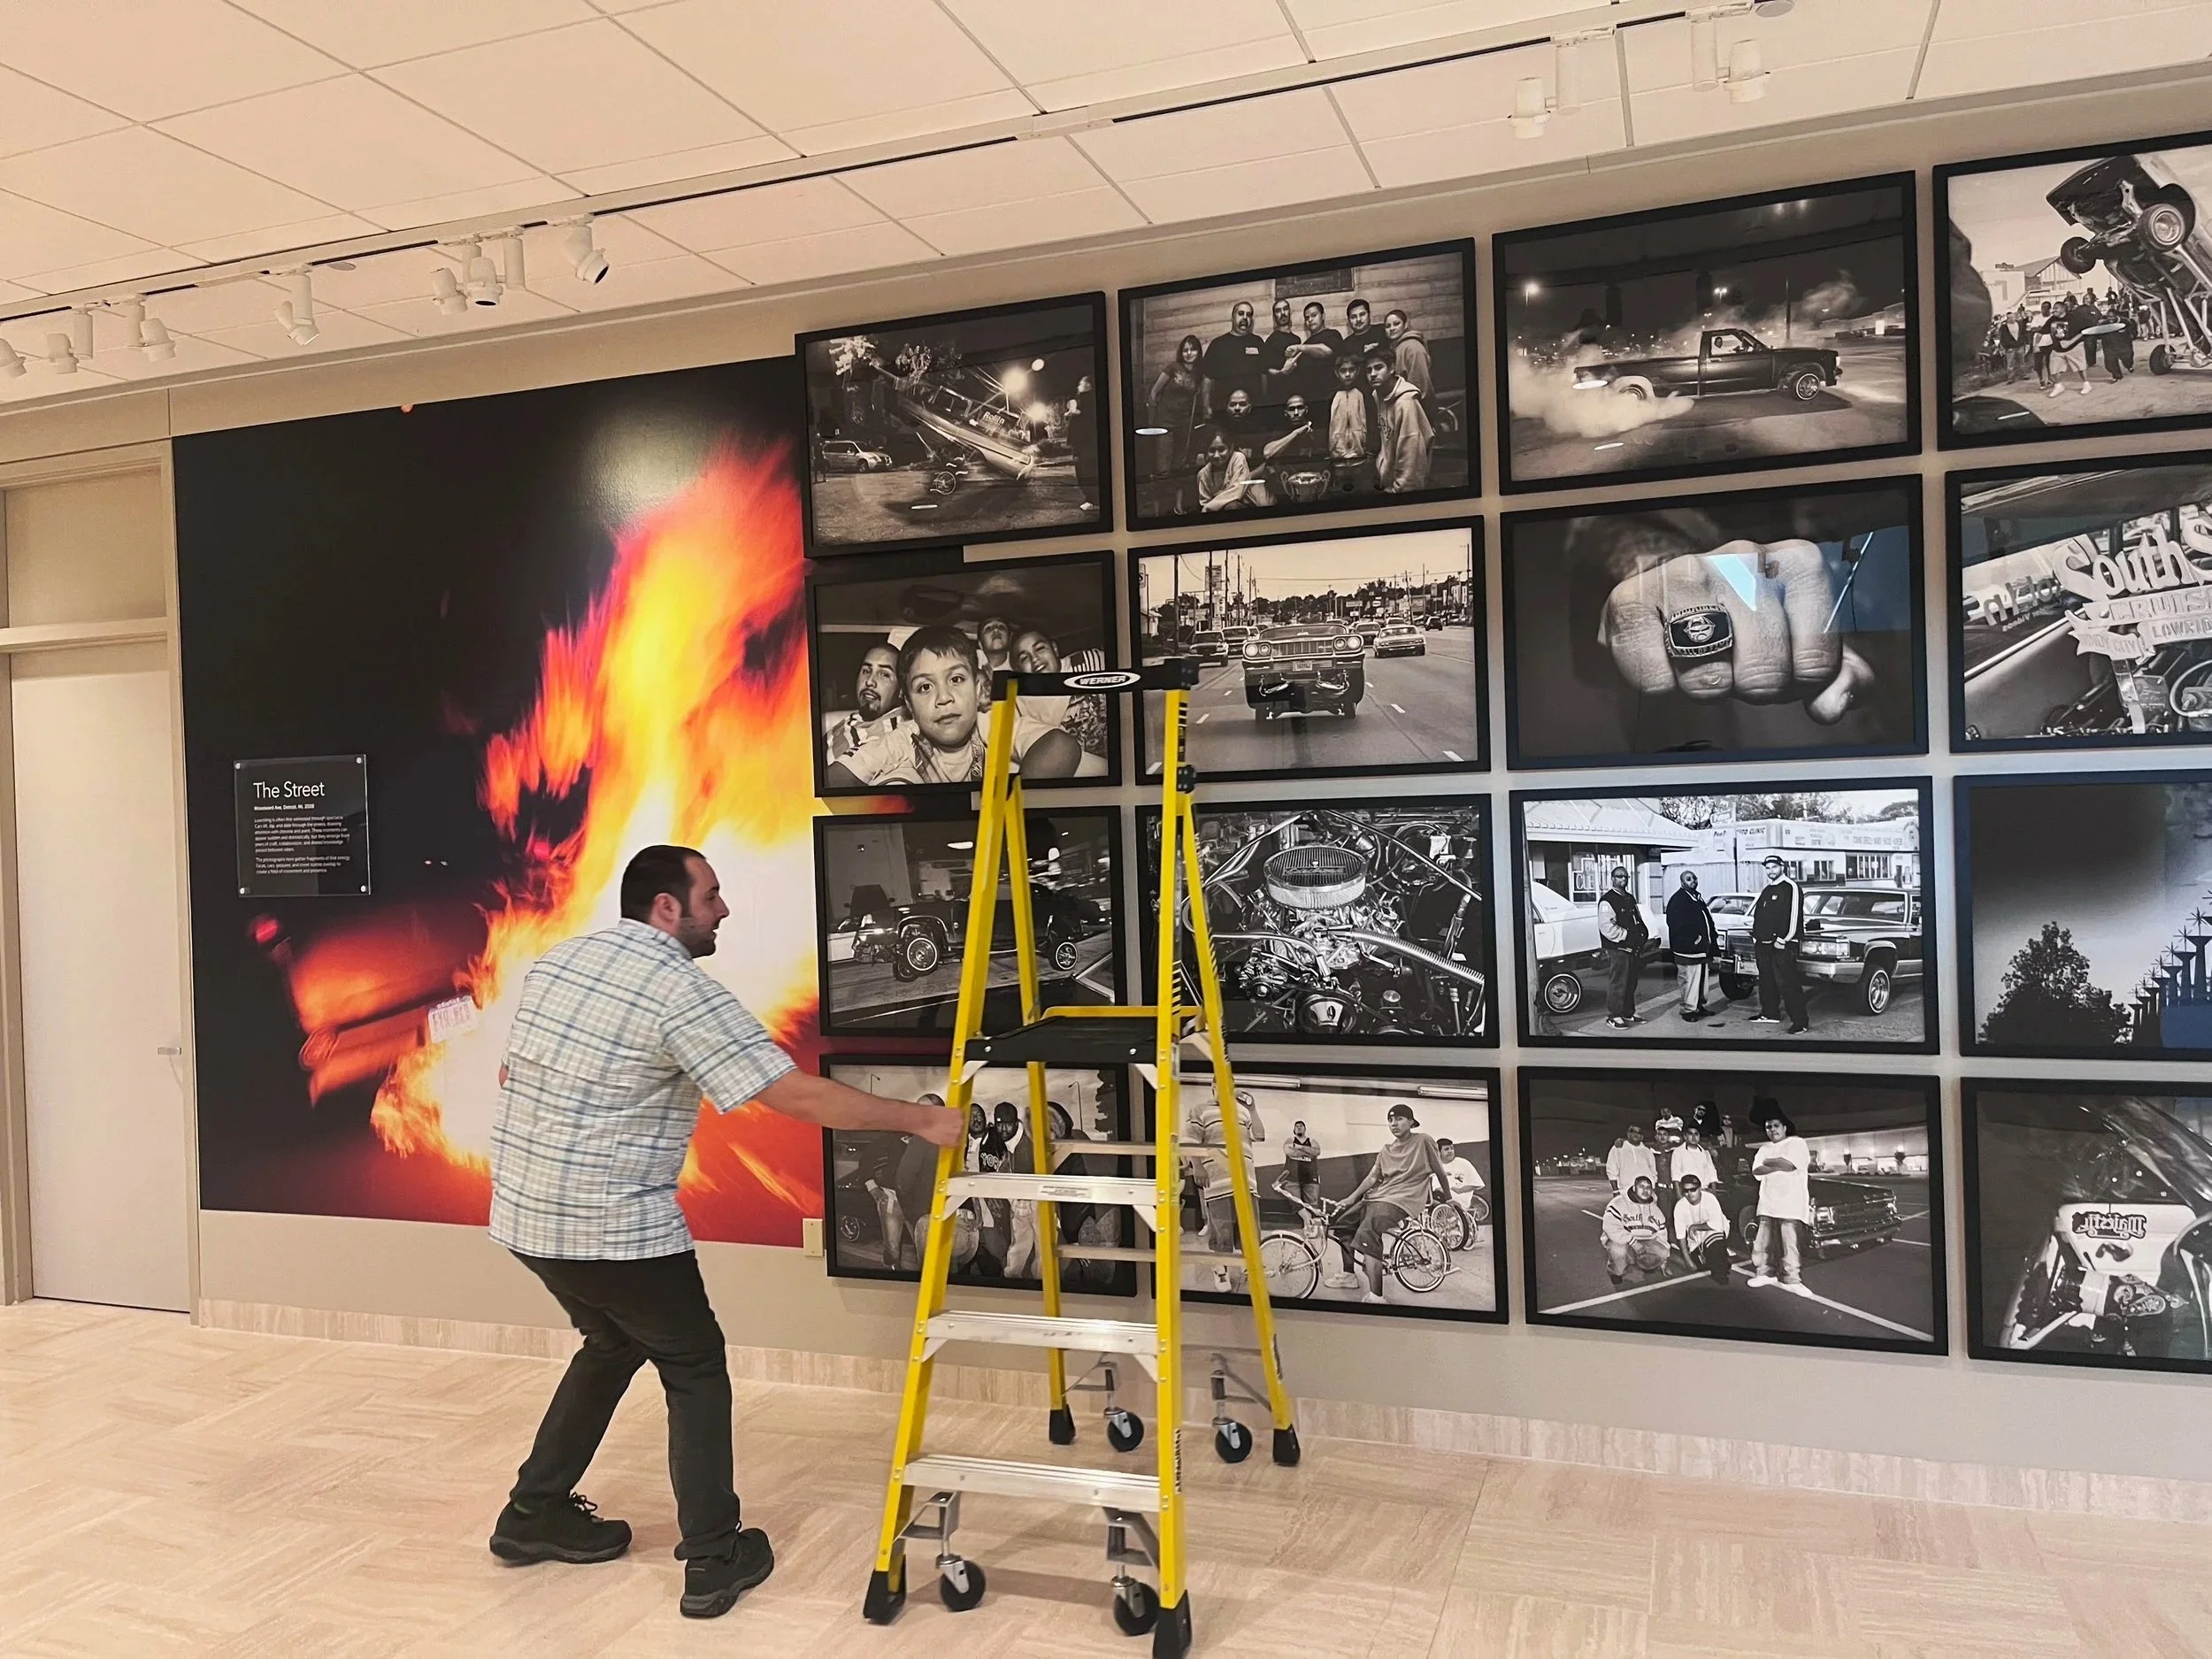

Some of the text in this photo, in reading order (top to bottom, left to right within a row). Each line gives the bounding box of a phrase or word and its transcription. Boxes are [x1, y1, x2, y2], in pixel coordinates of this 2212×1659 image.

[2053, 525, 2197, 601] South
[1079, 675, 1126, 686] WERNER
[253, 780, 326, 798] The Street
